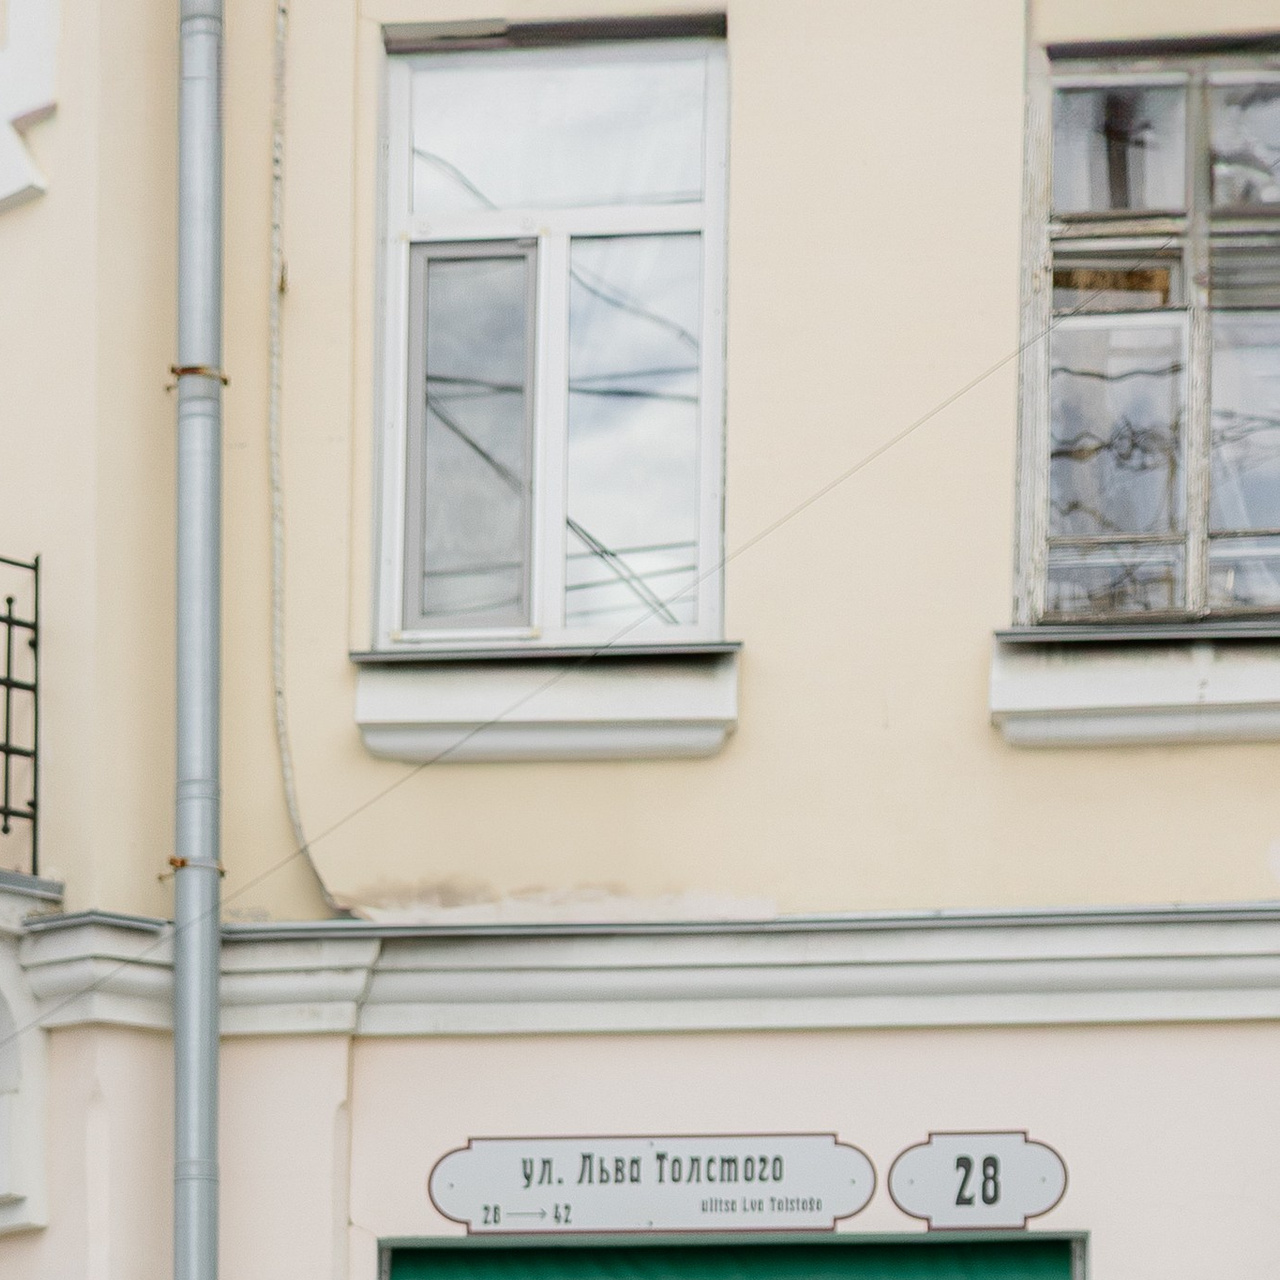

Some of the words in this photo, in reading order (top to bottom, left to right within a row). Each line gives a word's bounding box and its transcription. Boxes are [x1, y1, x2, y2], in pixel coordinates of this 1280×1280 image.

[521, 1156, 564, 1189] ул.
[577, 1153, 642, 1185] Льва
[656, 1151, 785, 1184] Толстого
[955, 1155, 1000, 1206] 28
[552, 1203, 573, 1225] 42
